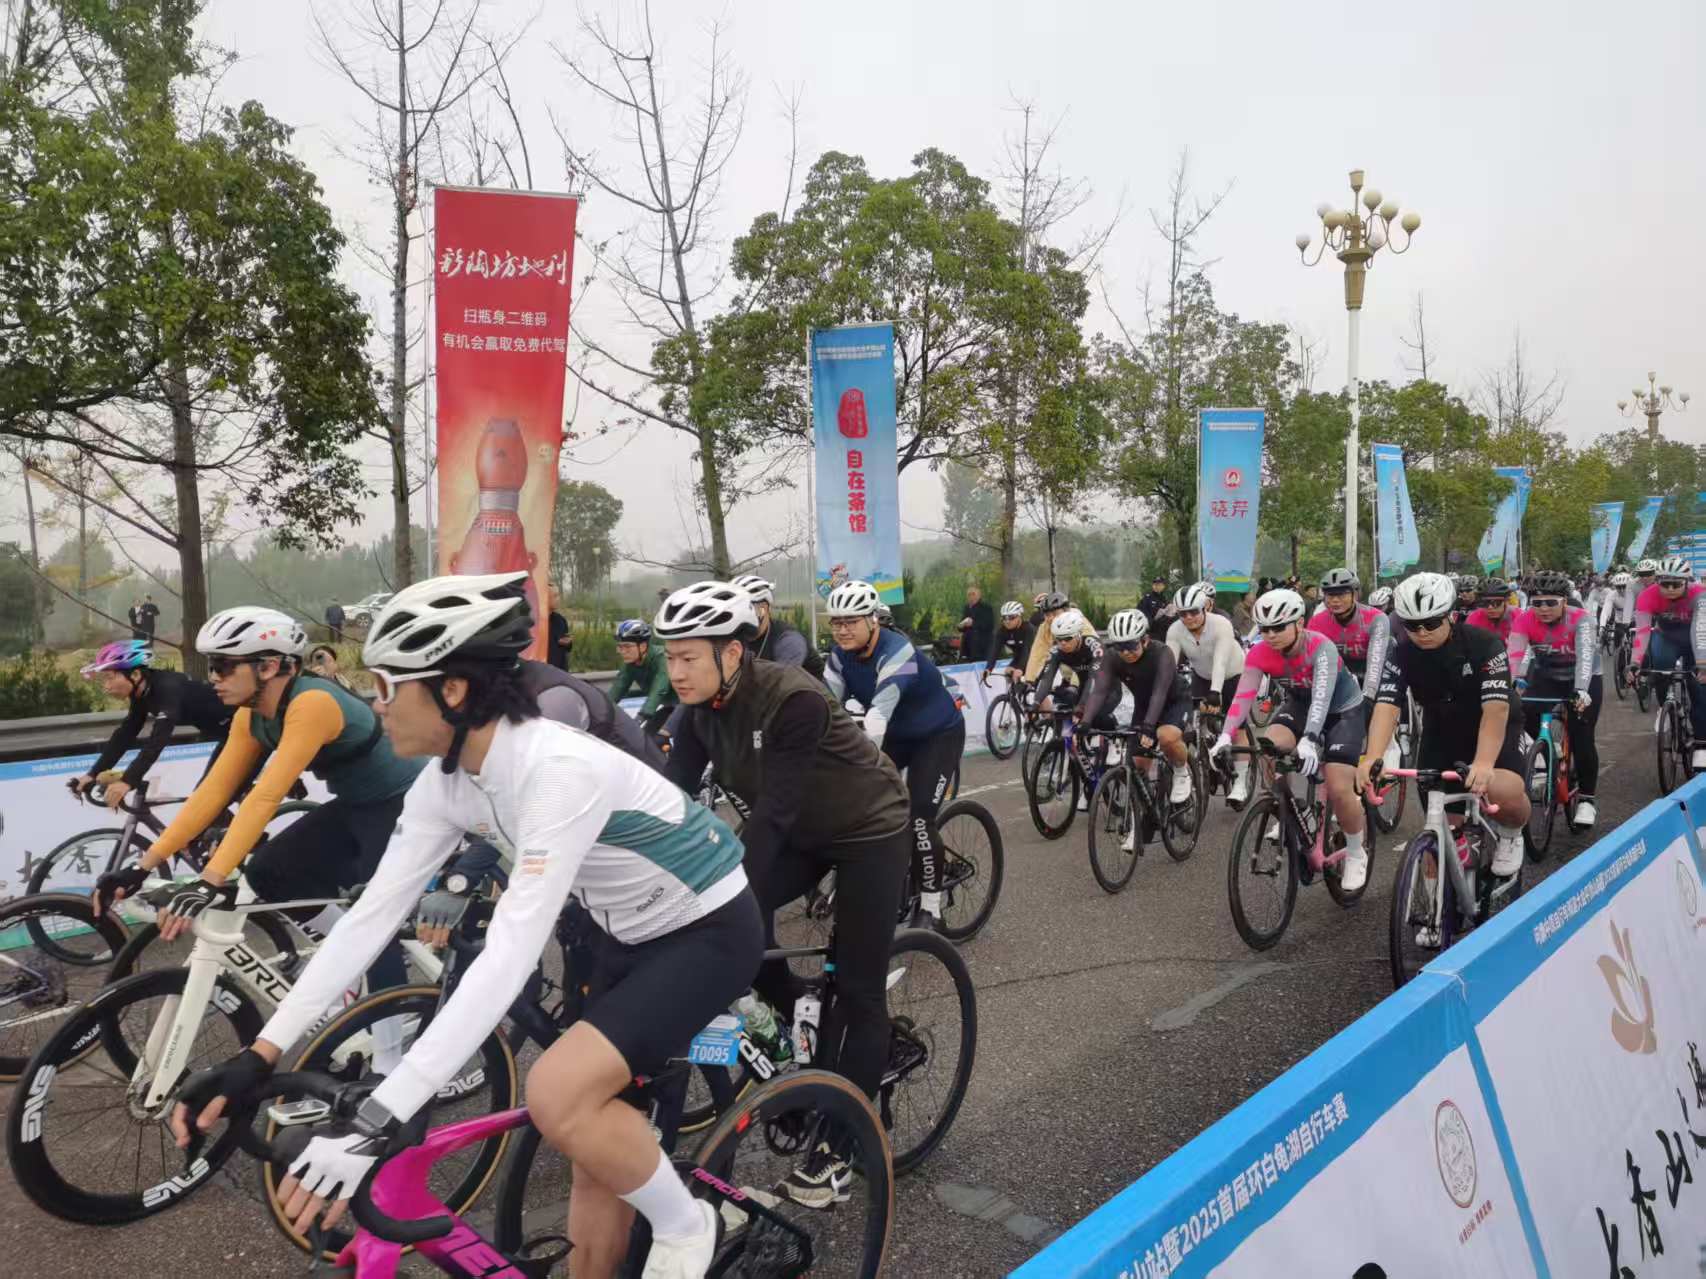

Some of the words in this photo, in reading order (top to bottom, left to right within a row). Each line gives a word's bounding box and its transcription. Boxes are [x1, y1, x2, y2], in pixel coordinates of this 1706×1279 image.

[463, 307, 547, 326] 扫瓶身二维码
[443, 332, 566, 352] 有机会赢取免费代驾
[847, 448, 867, 532] 自在茶馆
[692, 1045, 729, 1062] T0095
